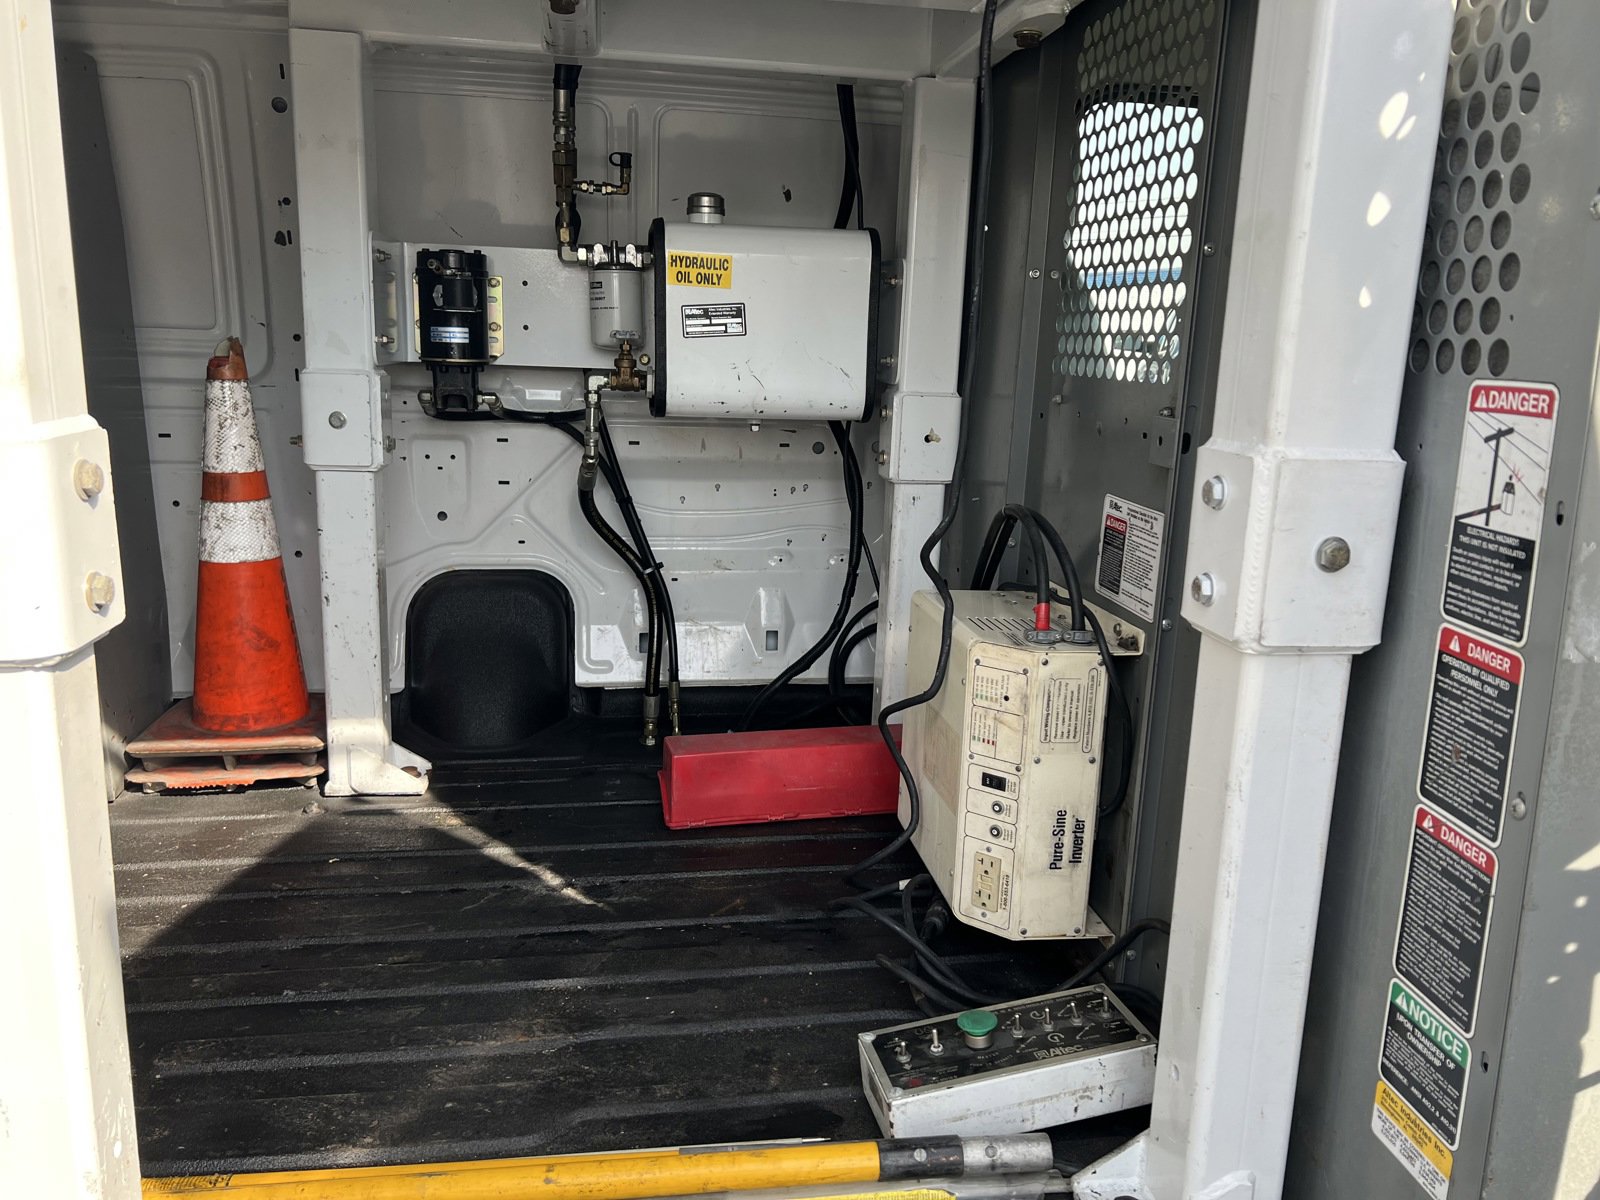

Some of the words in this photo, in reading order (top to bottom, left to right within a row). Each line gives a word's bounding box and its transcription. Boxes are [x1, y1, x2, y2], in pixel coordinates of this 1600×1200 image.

[670, 255, 729, 271] HYDRAULIC
[676, 271, 693, 284] OIL
[696, 272, 722, 285] ONLY
[1487, 390, 1549, 415] DANGER
[1110, 518, 1125, 531] DANGER
[1467, 527, 1495, 540] ELECTRICAL
[1459, 535, 1470, 543] THIS
[1489, 543, 1498, 551] NOT
[1499, 546, 1526, 560] INSULATED
[1442, 654, 1472, 674] OPERATION
[1472, 667, 1480, 678] BY
[1480, 671, 1510, 691] QUALIFIED
[1467, 643, 1511, 674] DANGER
[1451, 669, 1483, 691] PERSONNEL
[1483, 684, 1498, 698] ONLY
[1049, 810, 1067, 870] Pure-Sine
[1069, 818, 1085, 863] Inverter
[1441, 825, 1488, 867] DANGER
[1396, 1012, 1412, 1033] UPON
[1414, 1029, 1444, 1063] TRANSFER
[1446, 1058, 1455, 1073] OF
[1408, 1000, 1464, 1061] NOTICE
[1050, 1045, 1084, 1057] Altec
[1407, 1031, 1441, 1069] OWNERSHIP
[1383, 1088, 1398, 1108] Altec
[1400, 1106, 1431, 1143] Industries
[1434, 1141, 1446, 1159] Inc.
